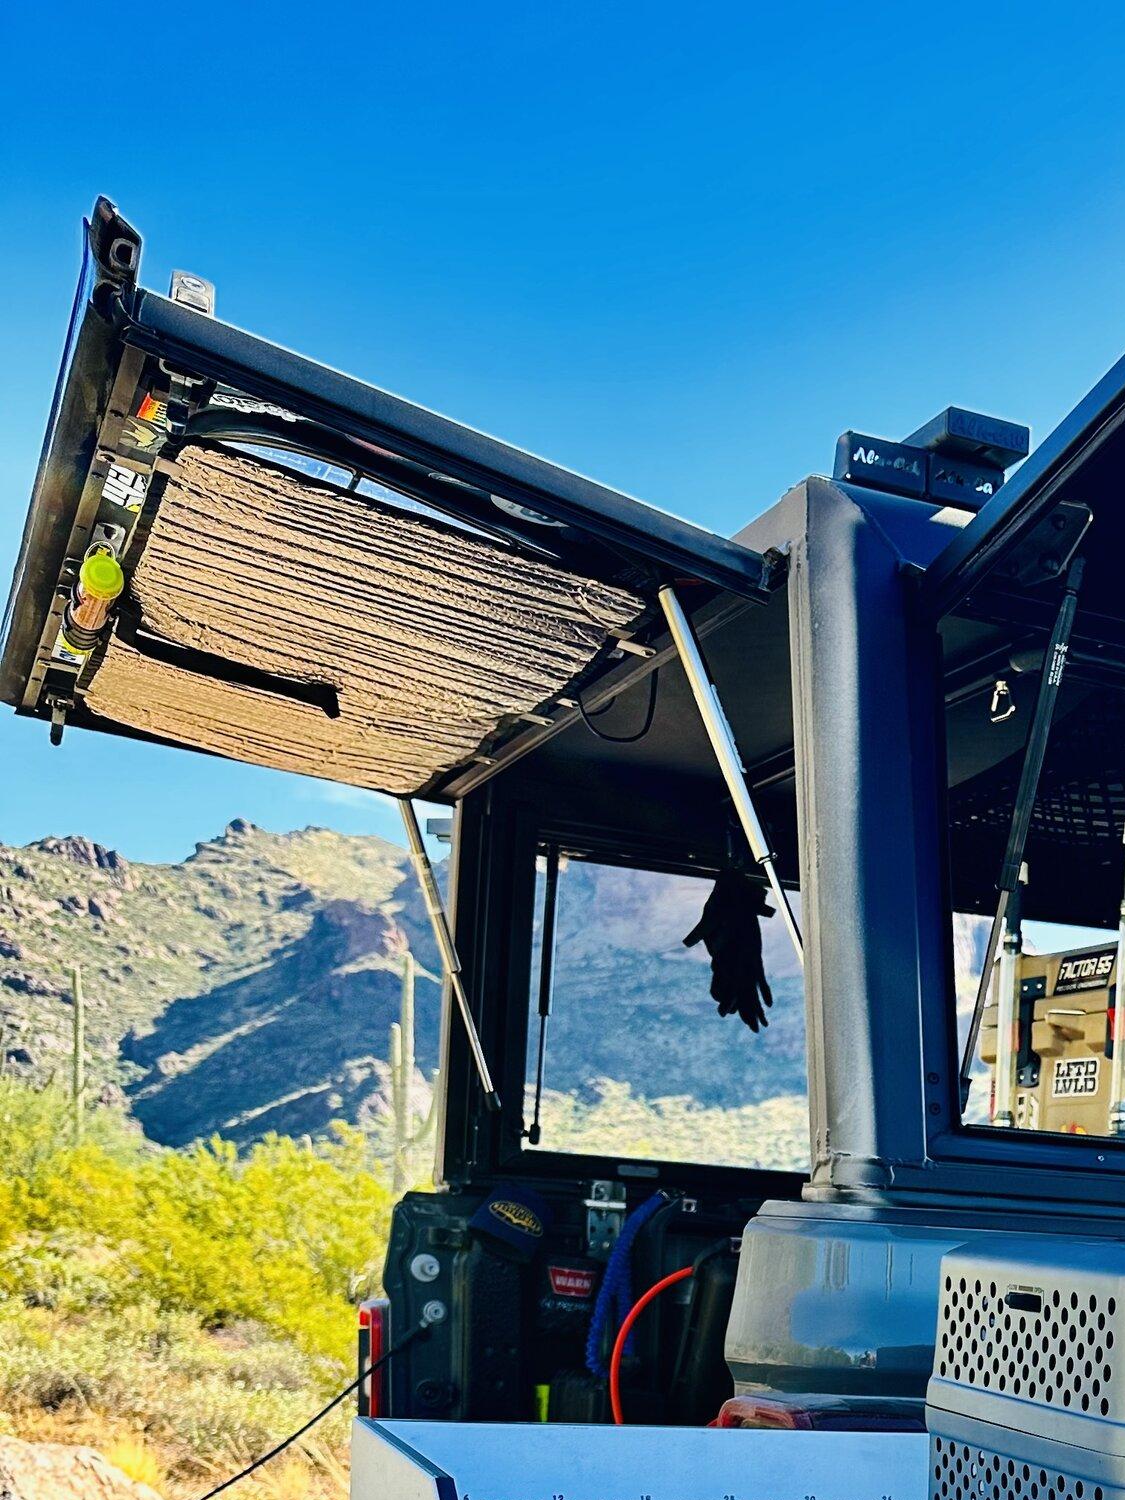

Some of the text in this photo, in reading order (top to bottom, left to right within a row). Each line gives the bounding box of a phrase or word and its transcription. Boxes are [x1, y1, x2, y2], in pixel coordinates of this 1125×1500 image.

[1059, 955, 1114, 980] FACTOR 55
[1056, 1060, 1097, 1078] LFTD
[1055, 1077, 1096, 1094] LVLD
[555, 1275, 591, 1289] WARN
